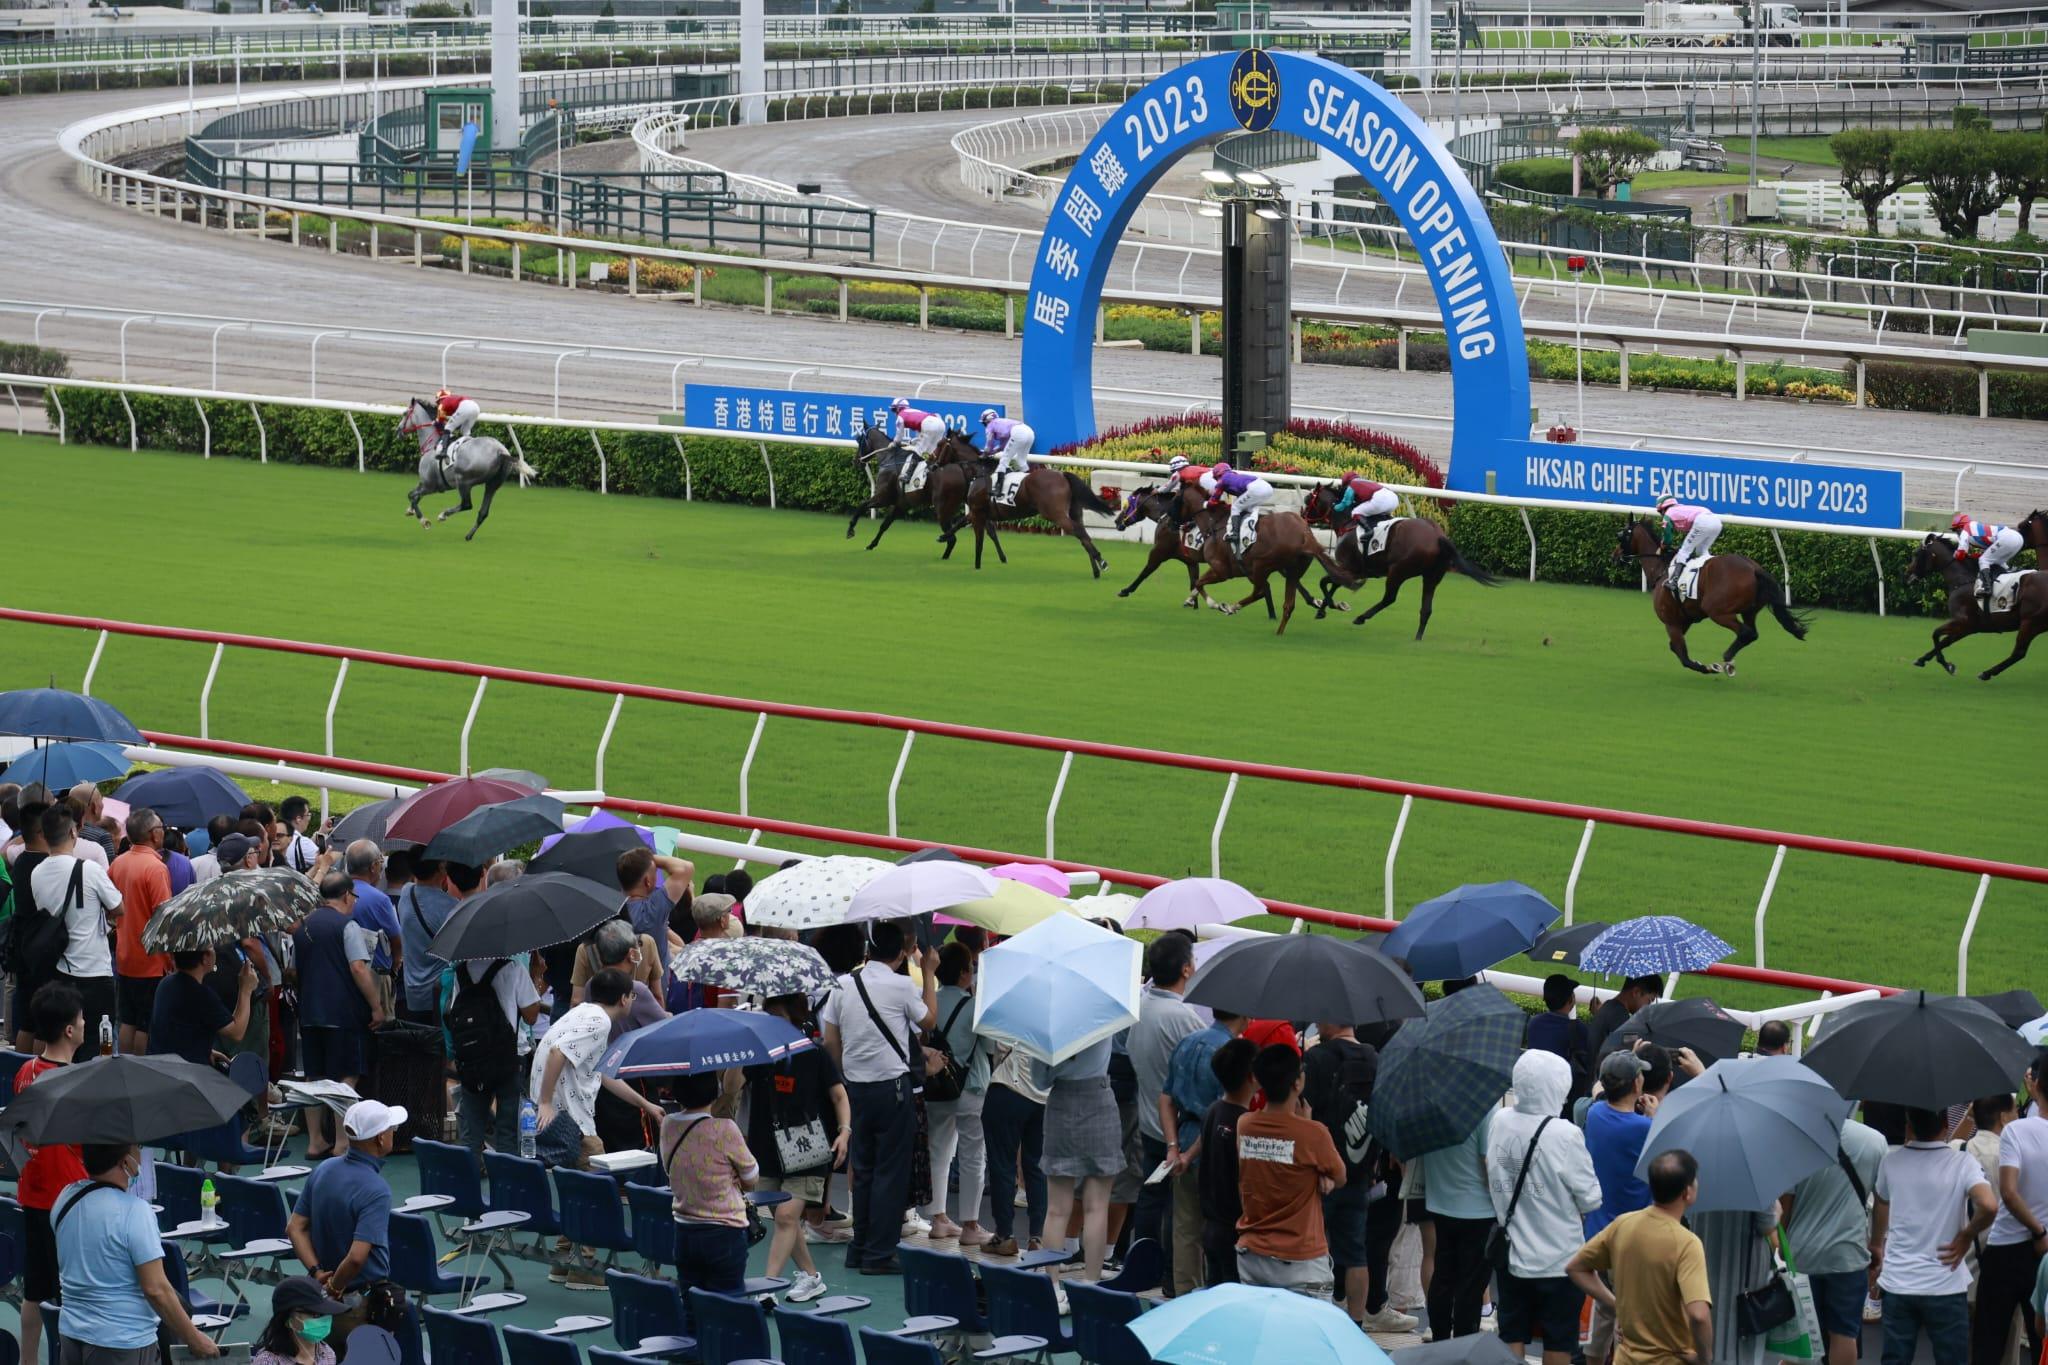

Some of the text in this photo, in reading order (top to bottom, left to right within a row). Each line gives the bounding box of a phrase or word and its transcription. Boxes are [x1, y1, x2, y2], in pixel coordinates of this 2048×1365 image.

[1034, 76, 1214, 333] 馬季開鑼 2023
[1304, 79, 1495, 359] SEASON OPENING
[714, 398, 911, 440] 香港特區行政長官
[1527, 457, 1867, 513] HKSAR CHIEF EXECUTIVE'S CUP 2023
[1687, 568, 1699, 598] 7
